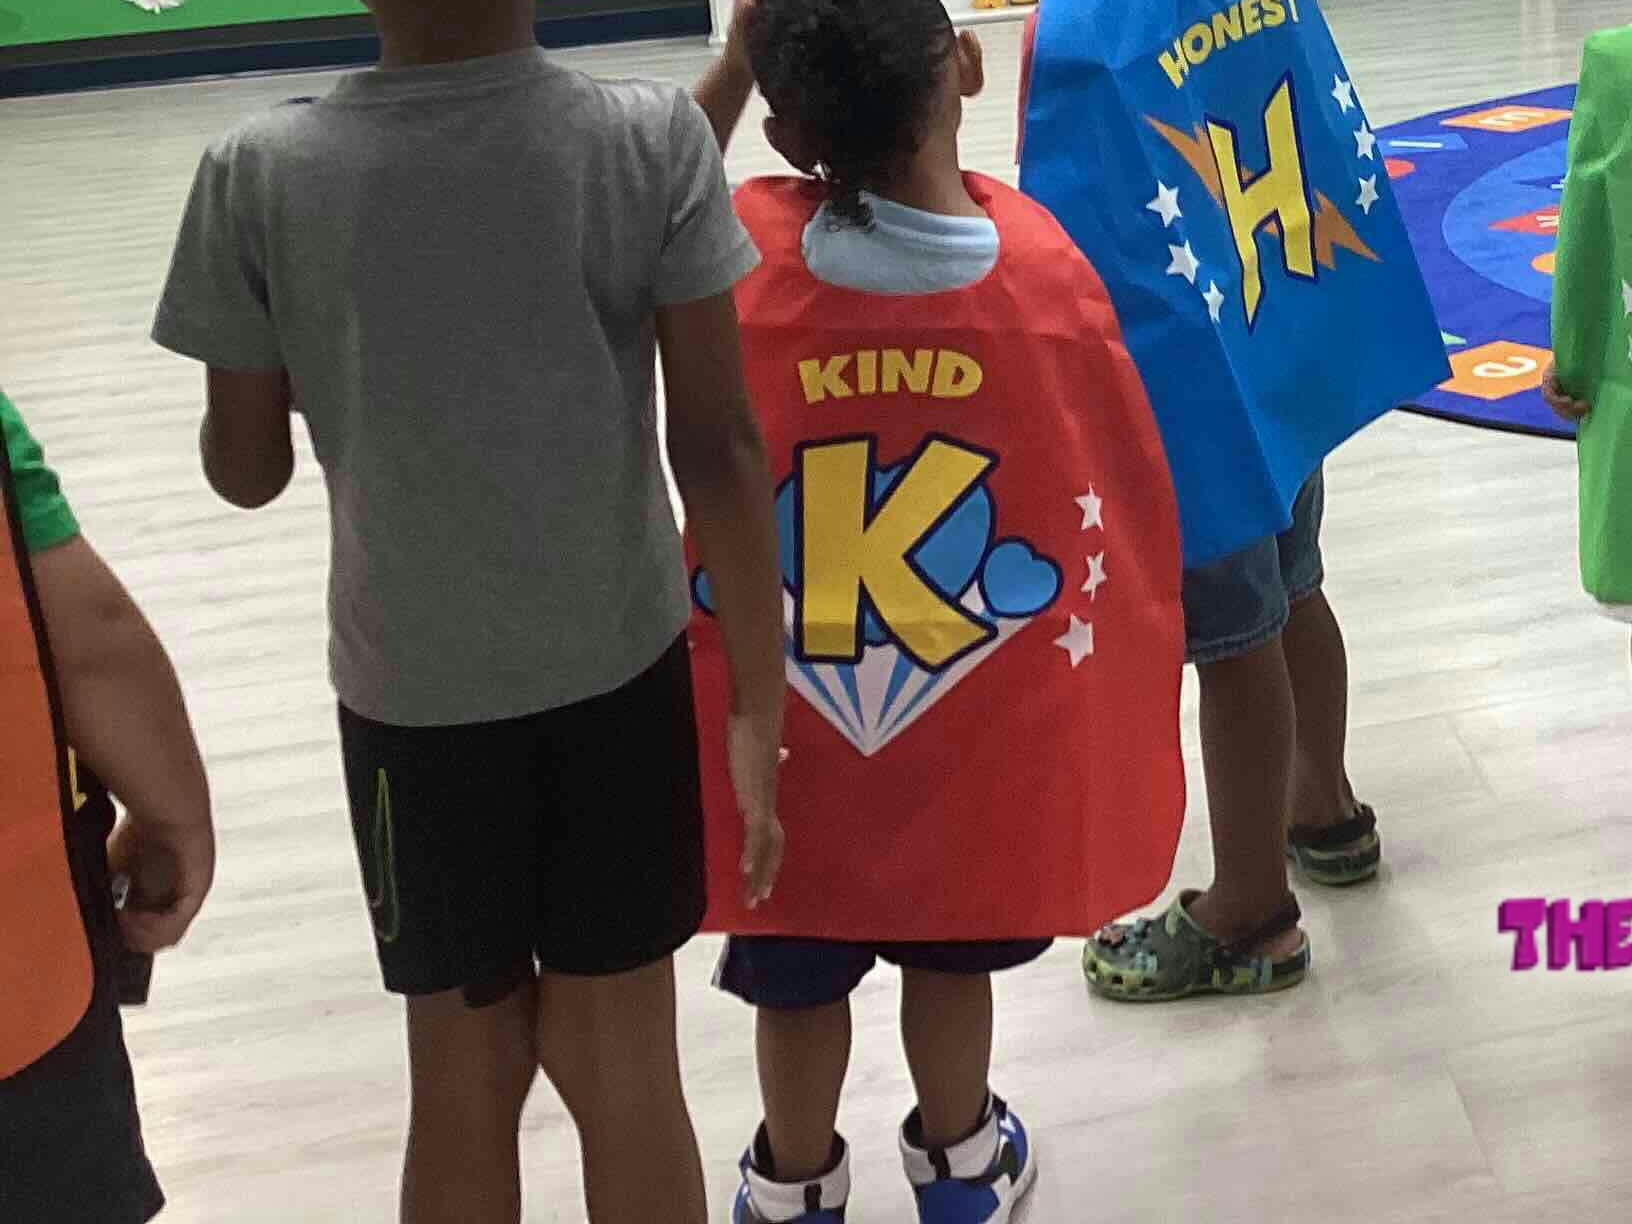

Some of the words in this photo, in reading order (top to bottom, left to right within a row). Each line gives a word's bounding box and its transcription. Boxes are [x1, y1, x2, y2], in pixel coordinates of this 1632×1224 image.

[1204, 70, 1318, 334] H
[798, 348, 984, 404] KIND
[795, 432, 998, 674] K
